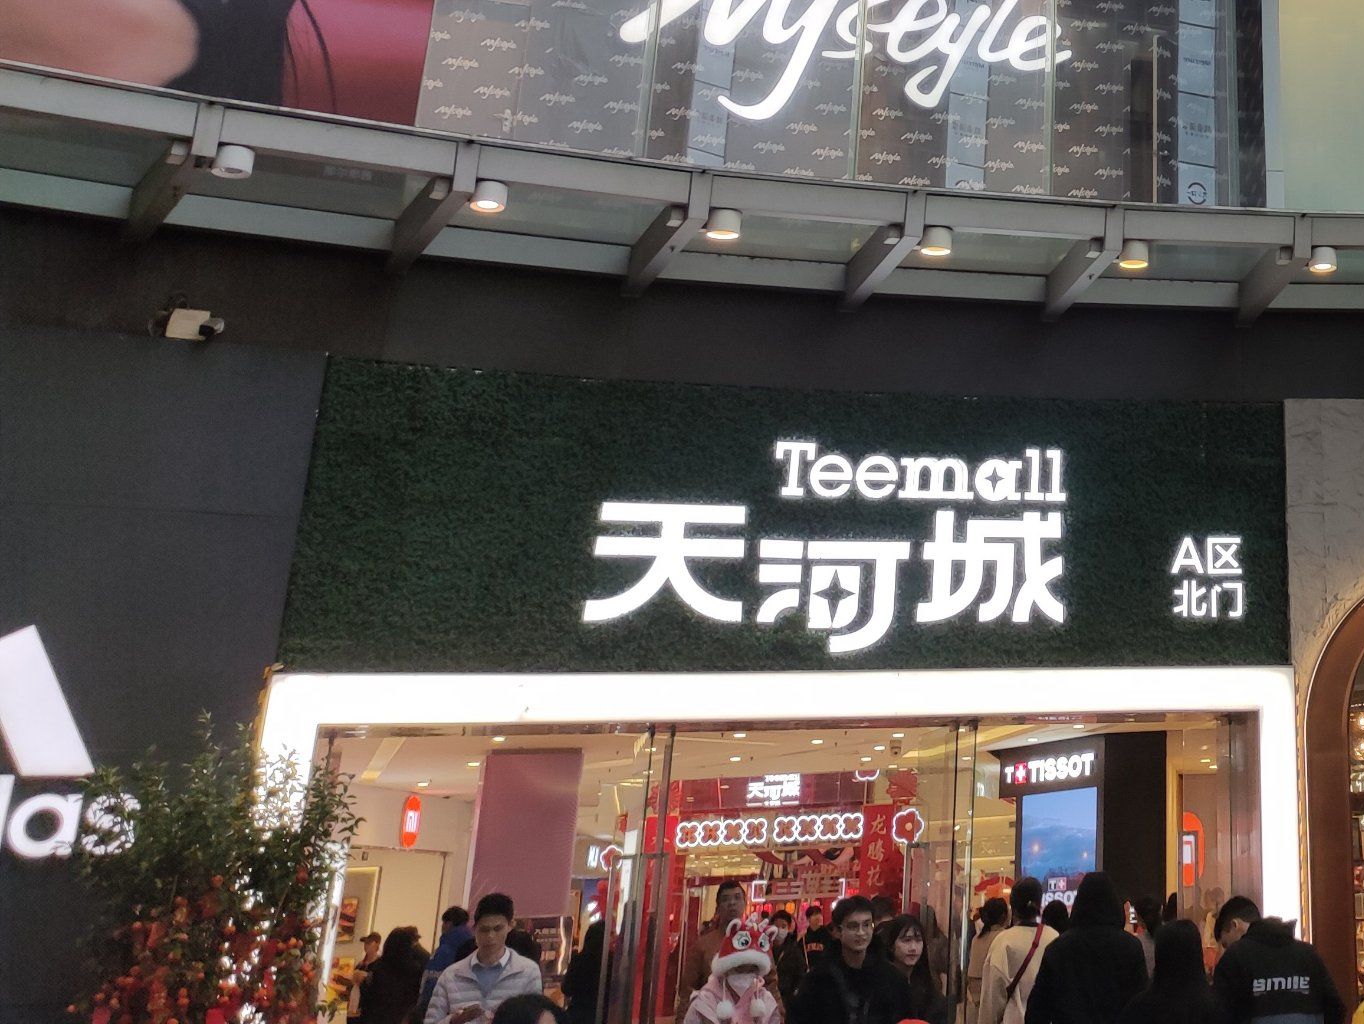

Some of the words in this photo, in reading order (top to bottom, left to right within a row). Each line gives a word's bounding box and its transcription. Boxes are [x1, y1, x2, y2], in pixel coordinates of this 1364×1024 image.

[773, 438, 1067, 503] Teemall
[582, 500, 1066, 654] 天河城
[1169, 534, 1244, 576] A区
[1171, 578, 1246, 619] 北门
[1027, 752, 1096, 784] TISSOT
[0, 774, 142, 859] as
